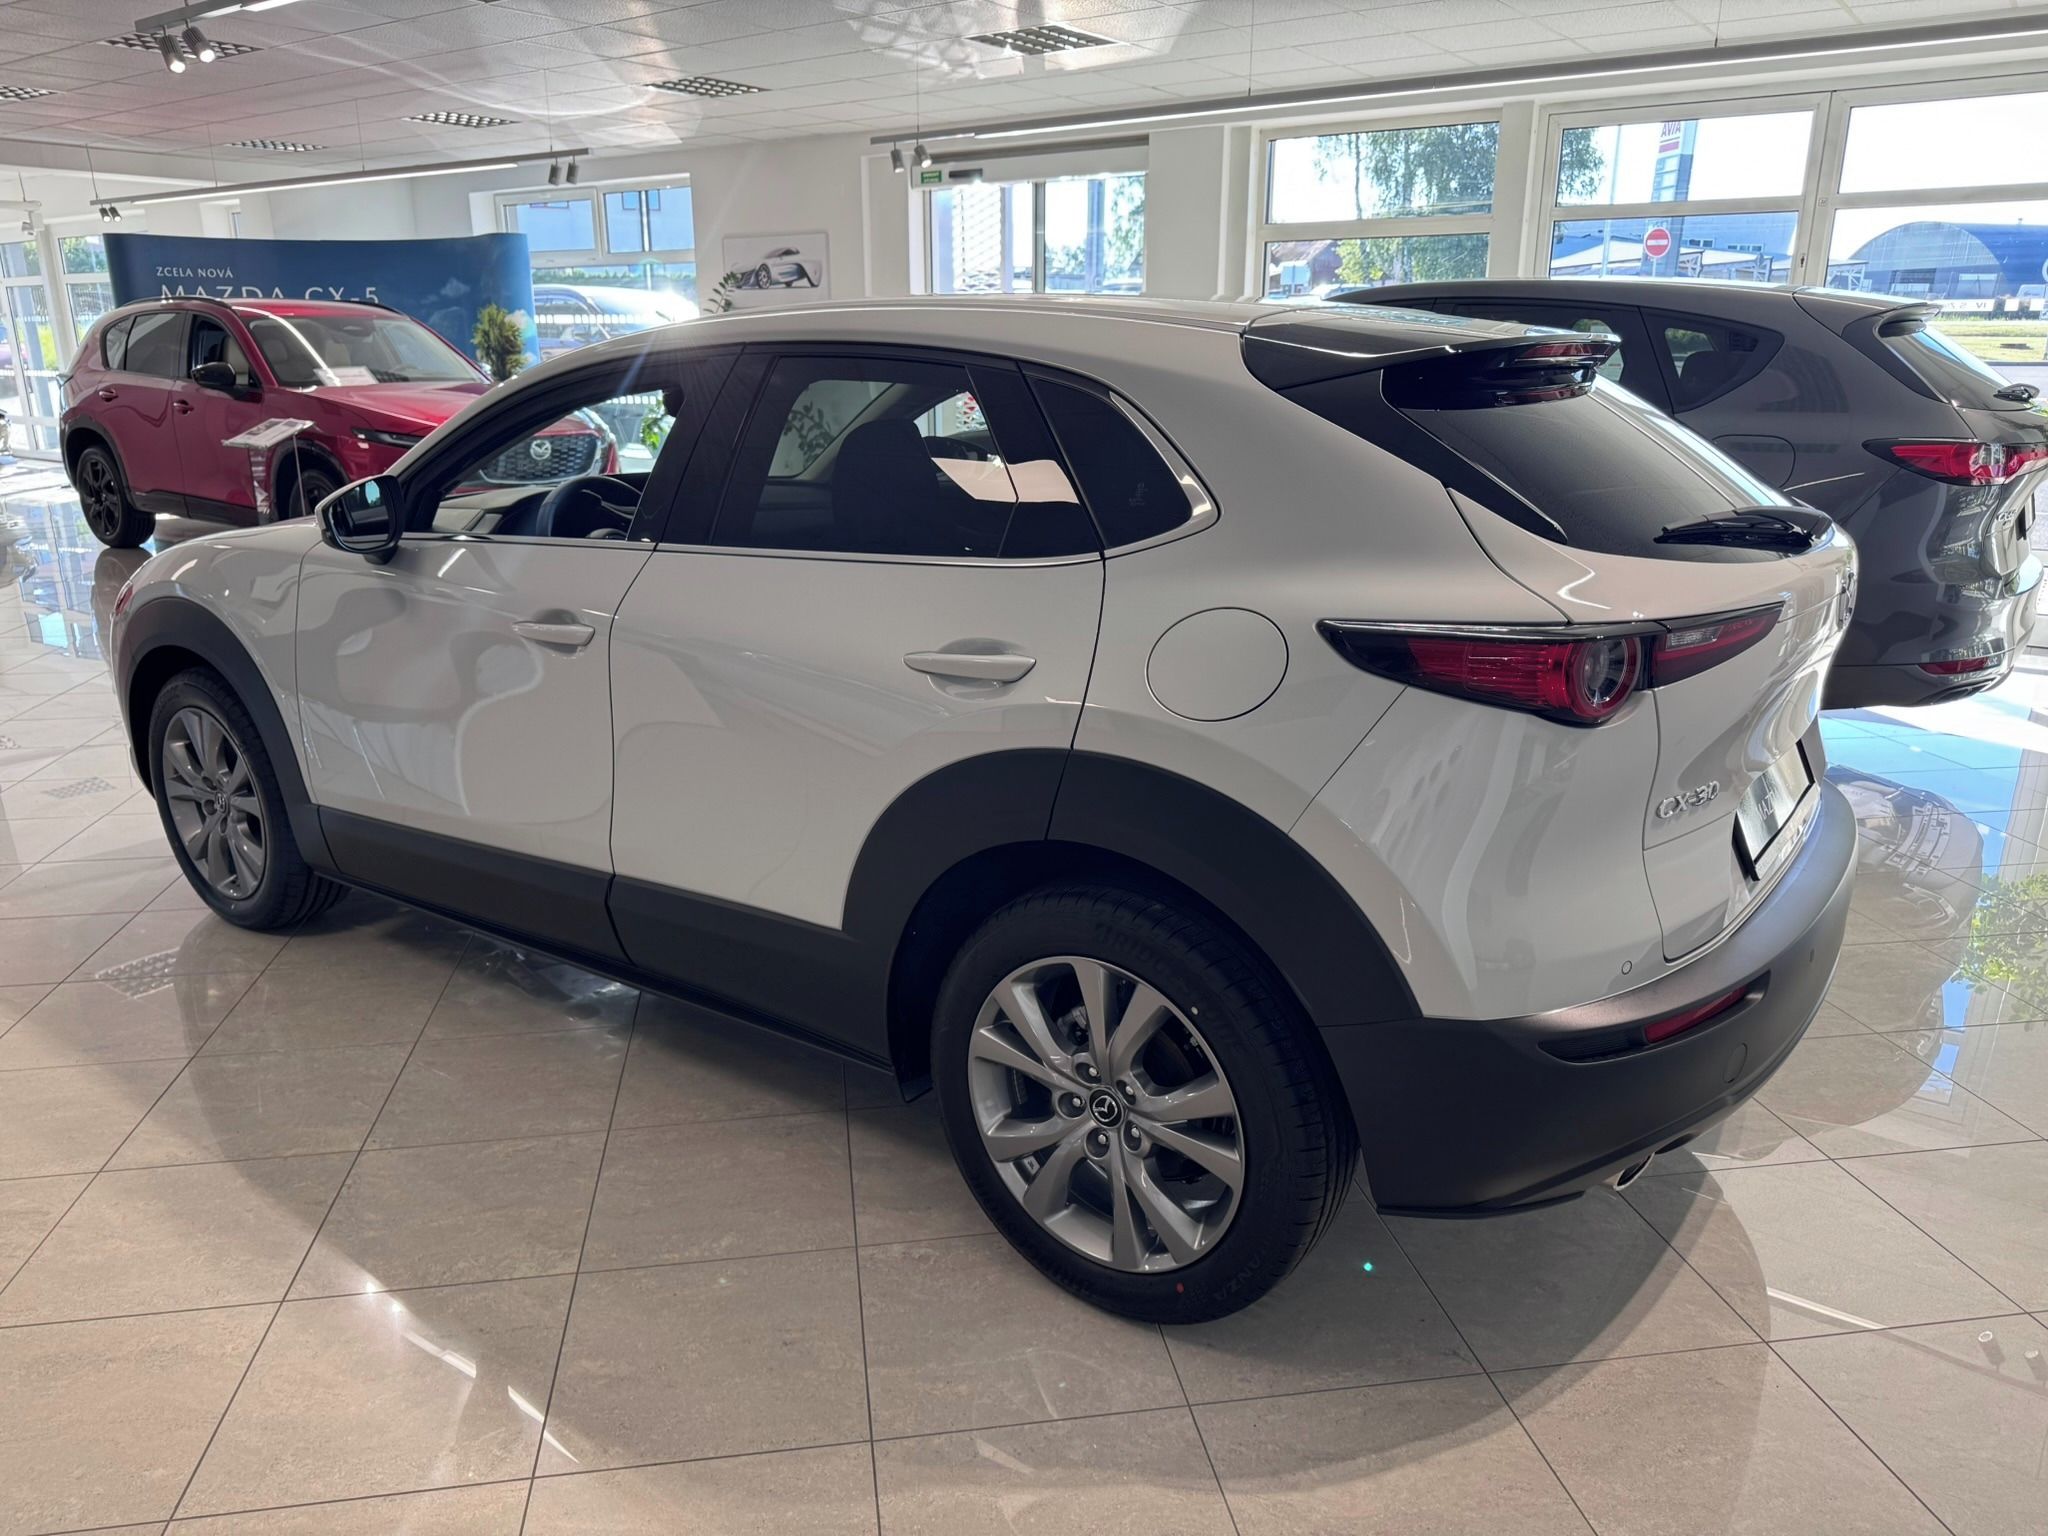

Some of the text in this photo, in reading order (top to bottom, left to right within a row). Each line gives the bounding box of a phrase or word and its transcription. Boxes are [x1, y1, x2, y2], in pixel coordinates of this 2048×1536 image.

[156, 266, 234, 278] ZCELA NOVÁ
[304, 286, 379, 304] CX-5
[1656, 780, 1720, 819] CX-30
